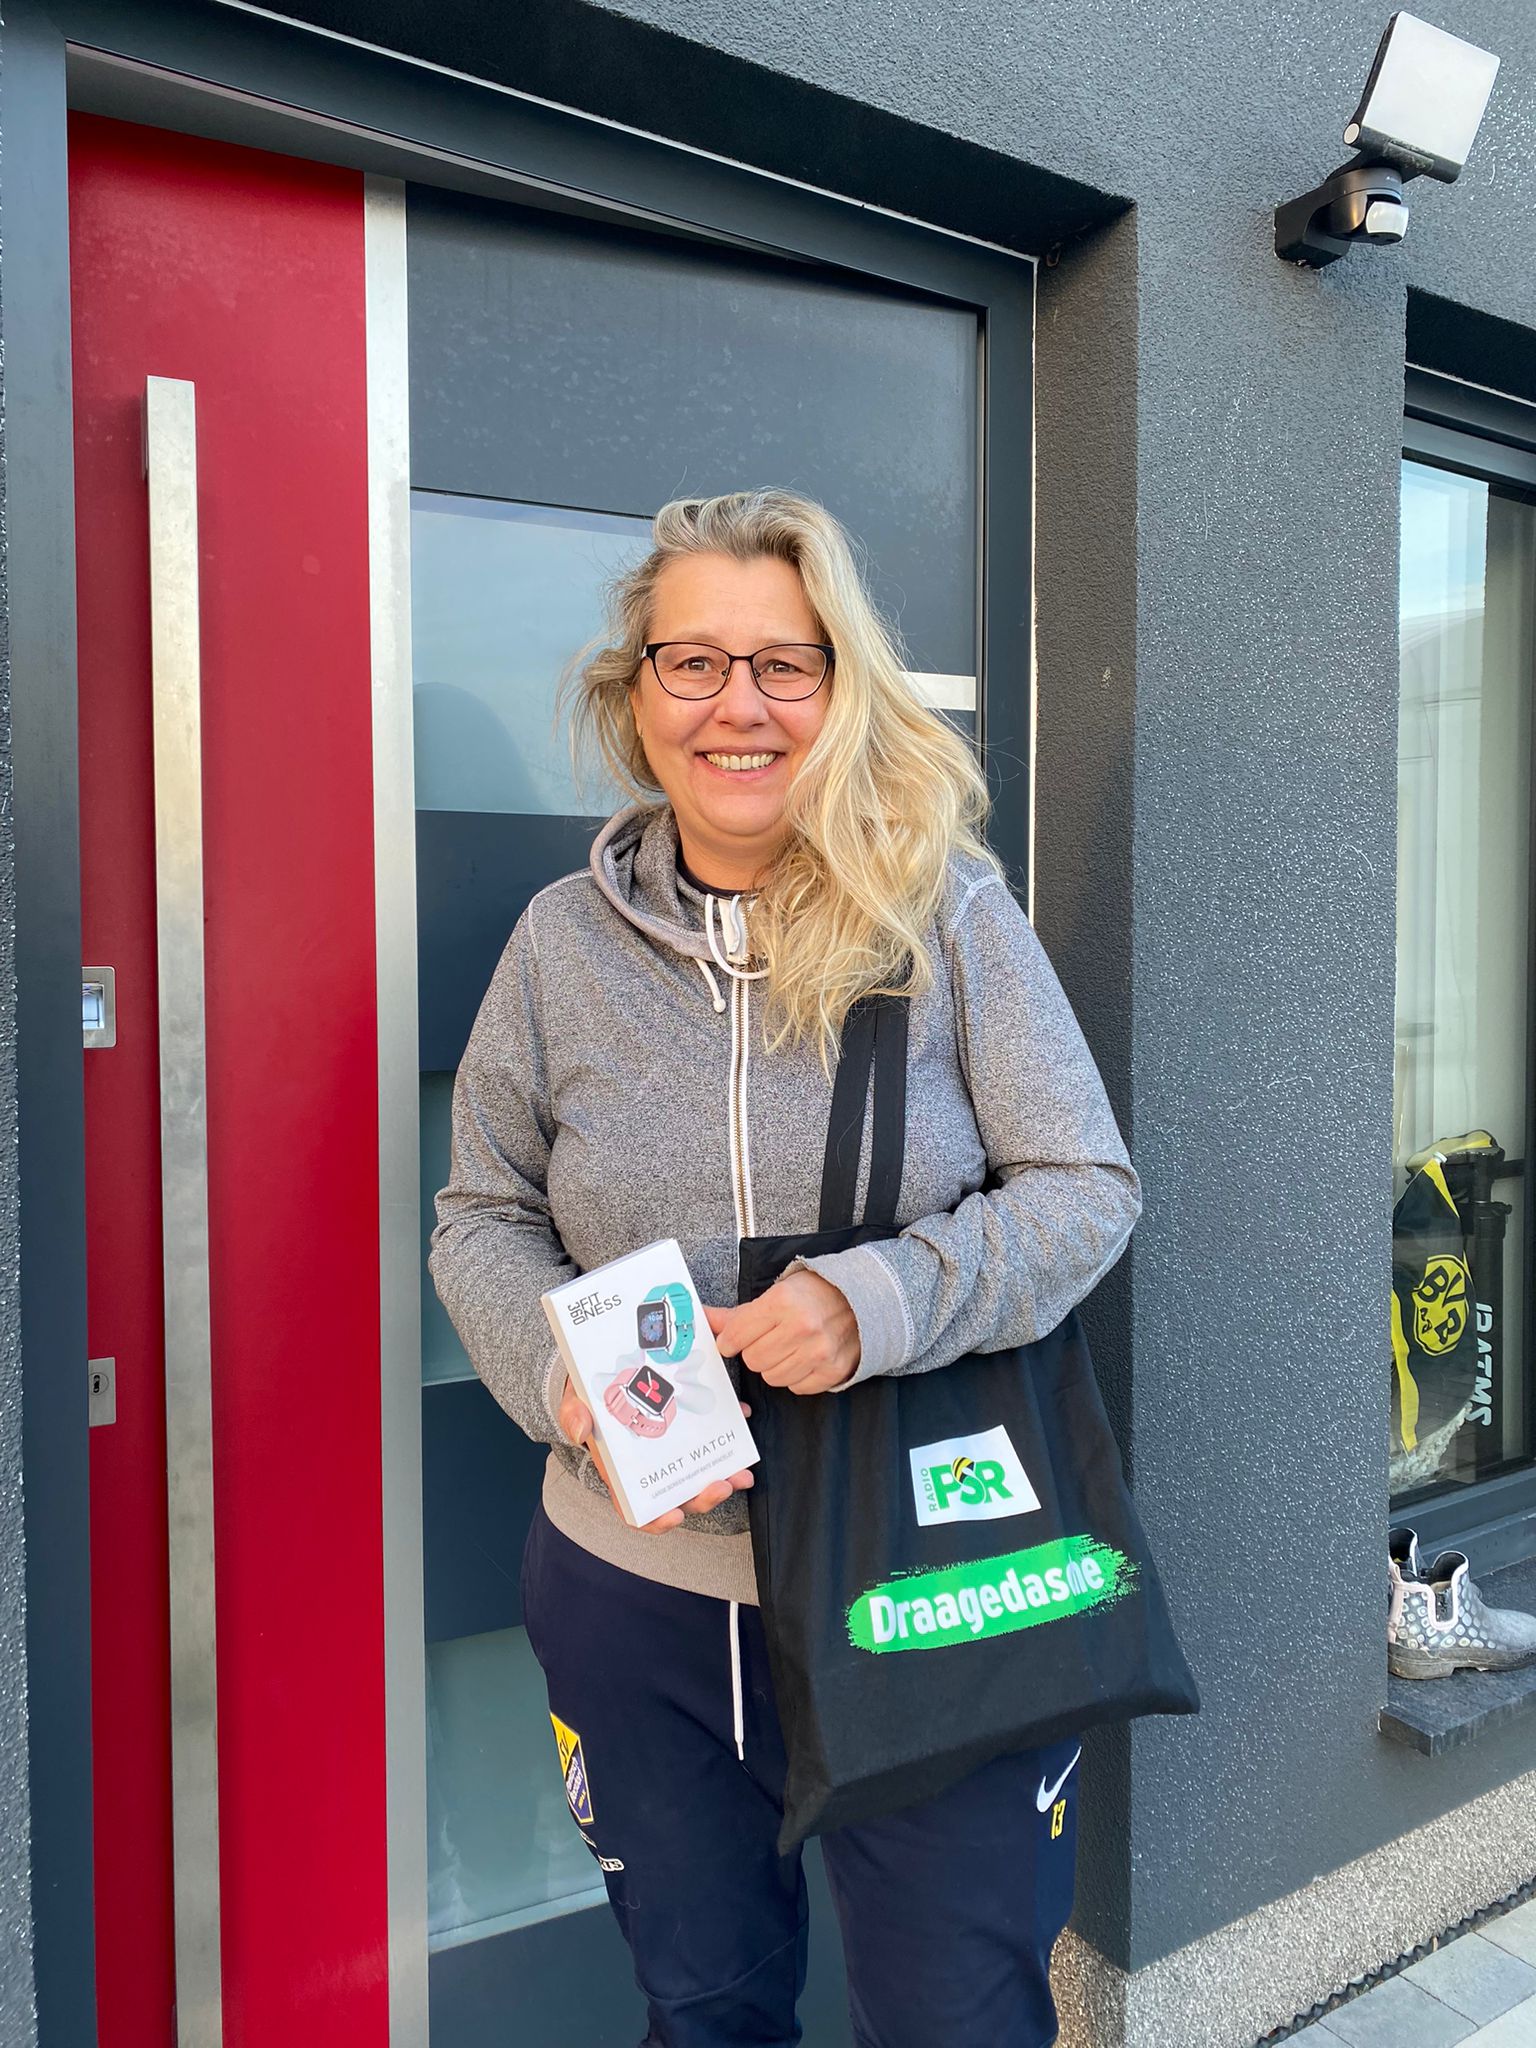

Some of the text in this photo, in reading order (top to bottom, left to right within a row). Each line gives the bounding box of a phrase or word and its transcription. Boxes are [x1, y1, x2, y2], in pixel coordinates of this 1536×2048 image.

[567, 1301, 586, 1326] 360
[579, 1291, 599, 1311] FIT
[583, 1294, 622, 1321] NESS
[639, 1428, 736, 1489] SMART WATCH
[920, 1467, 939, 1513] RADIO
[929, 1456, 1015, 1510] PSR
